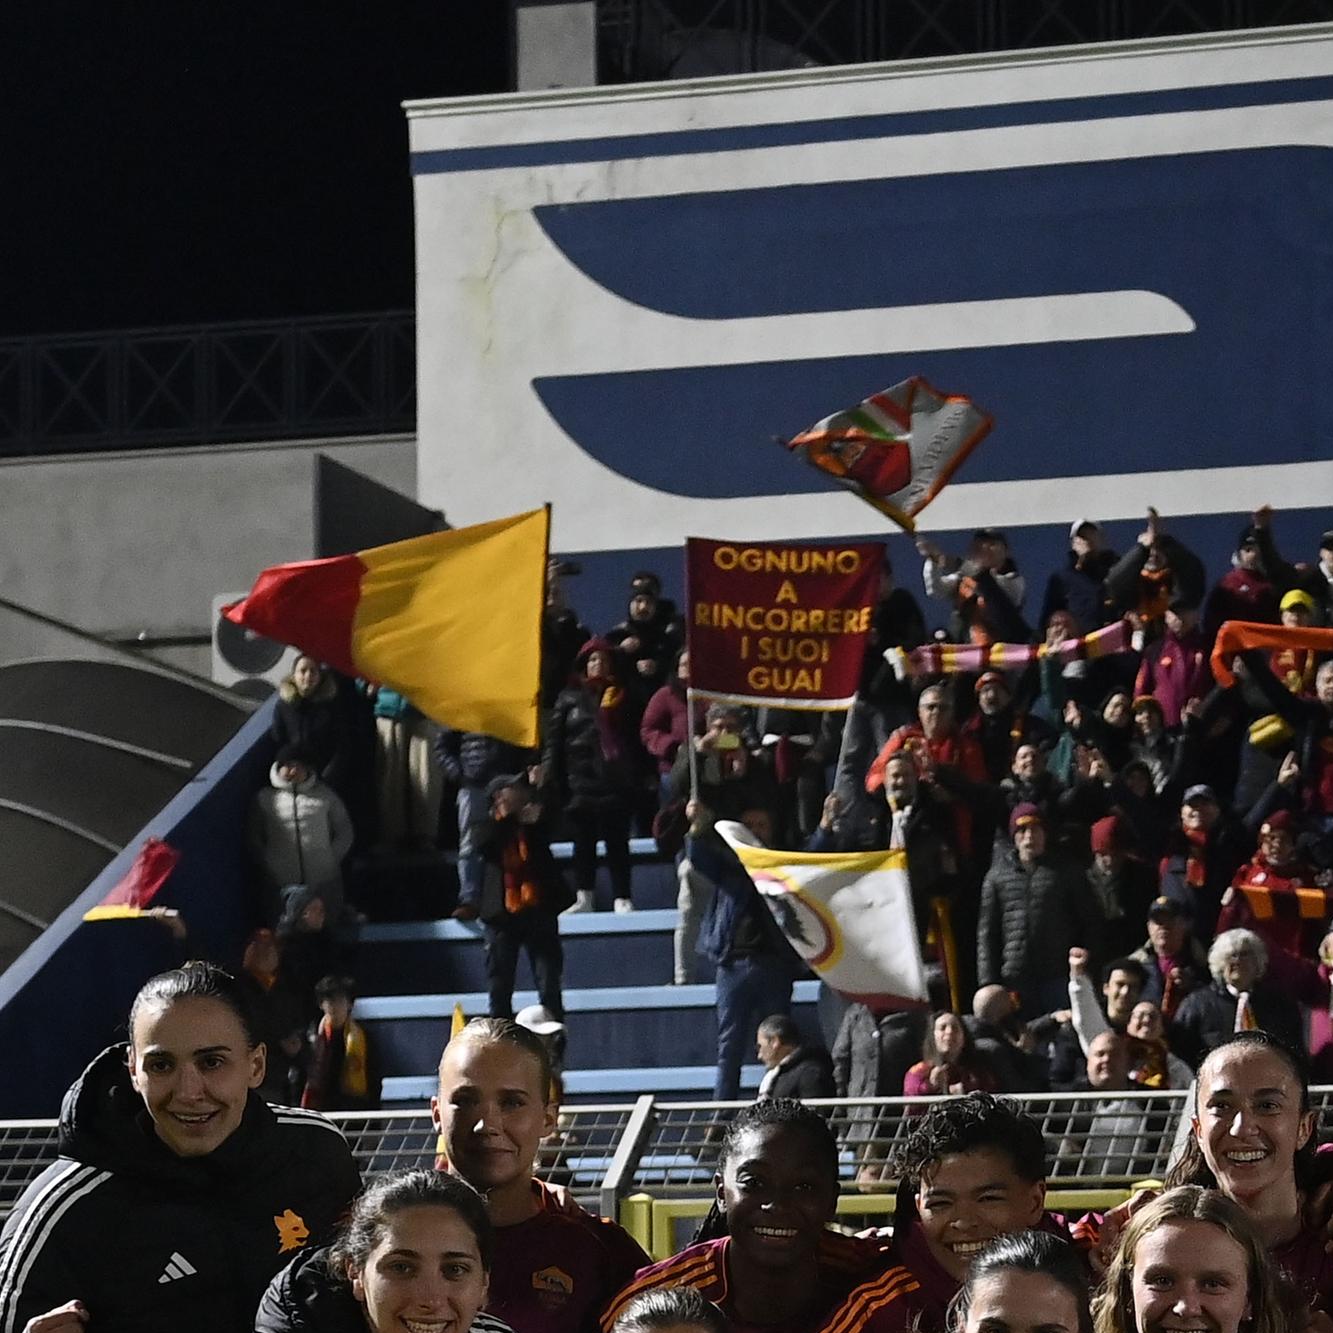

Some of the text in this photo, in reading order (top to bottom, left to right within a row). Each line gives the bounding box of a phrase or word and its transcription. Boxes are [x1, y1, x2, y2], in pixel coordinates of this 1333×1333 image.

[714, 547, 860, 574] OGNUNO
[776, 579, 798, 604] A
[695, 603, 872, 633] RINCORRERE
[741, 636, 829, 663] I SUOI
[748, 667, 822, 692] GUAI
